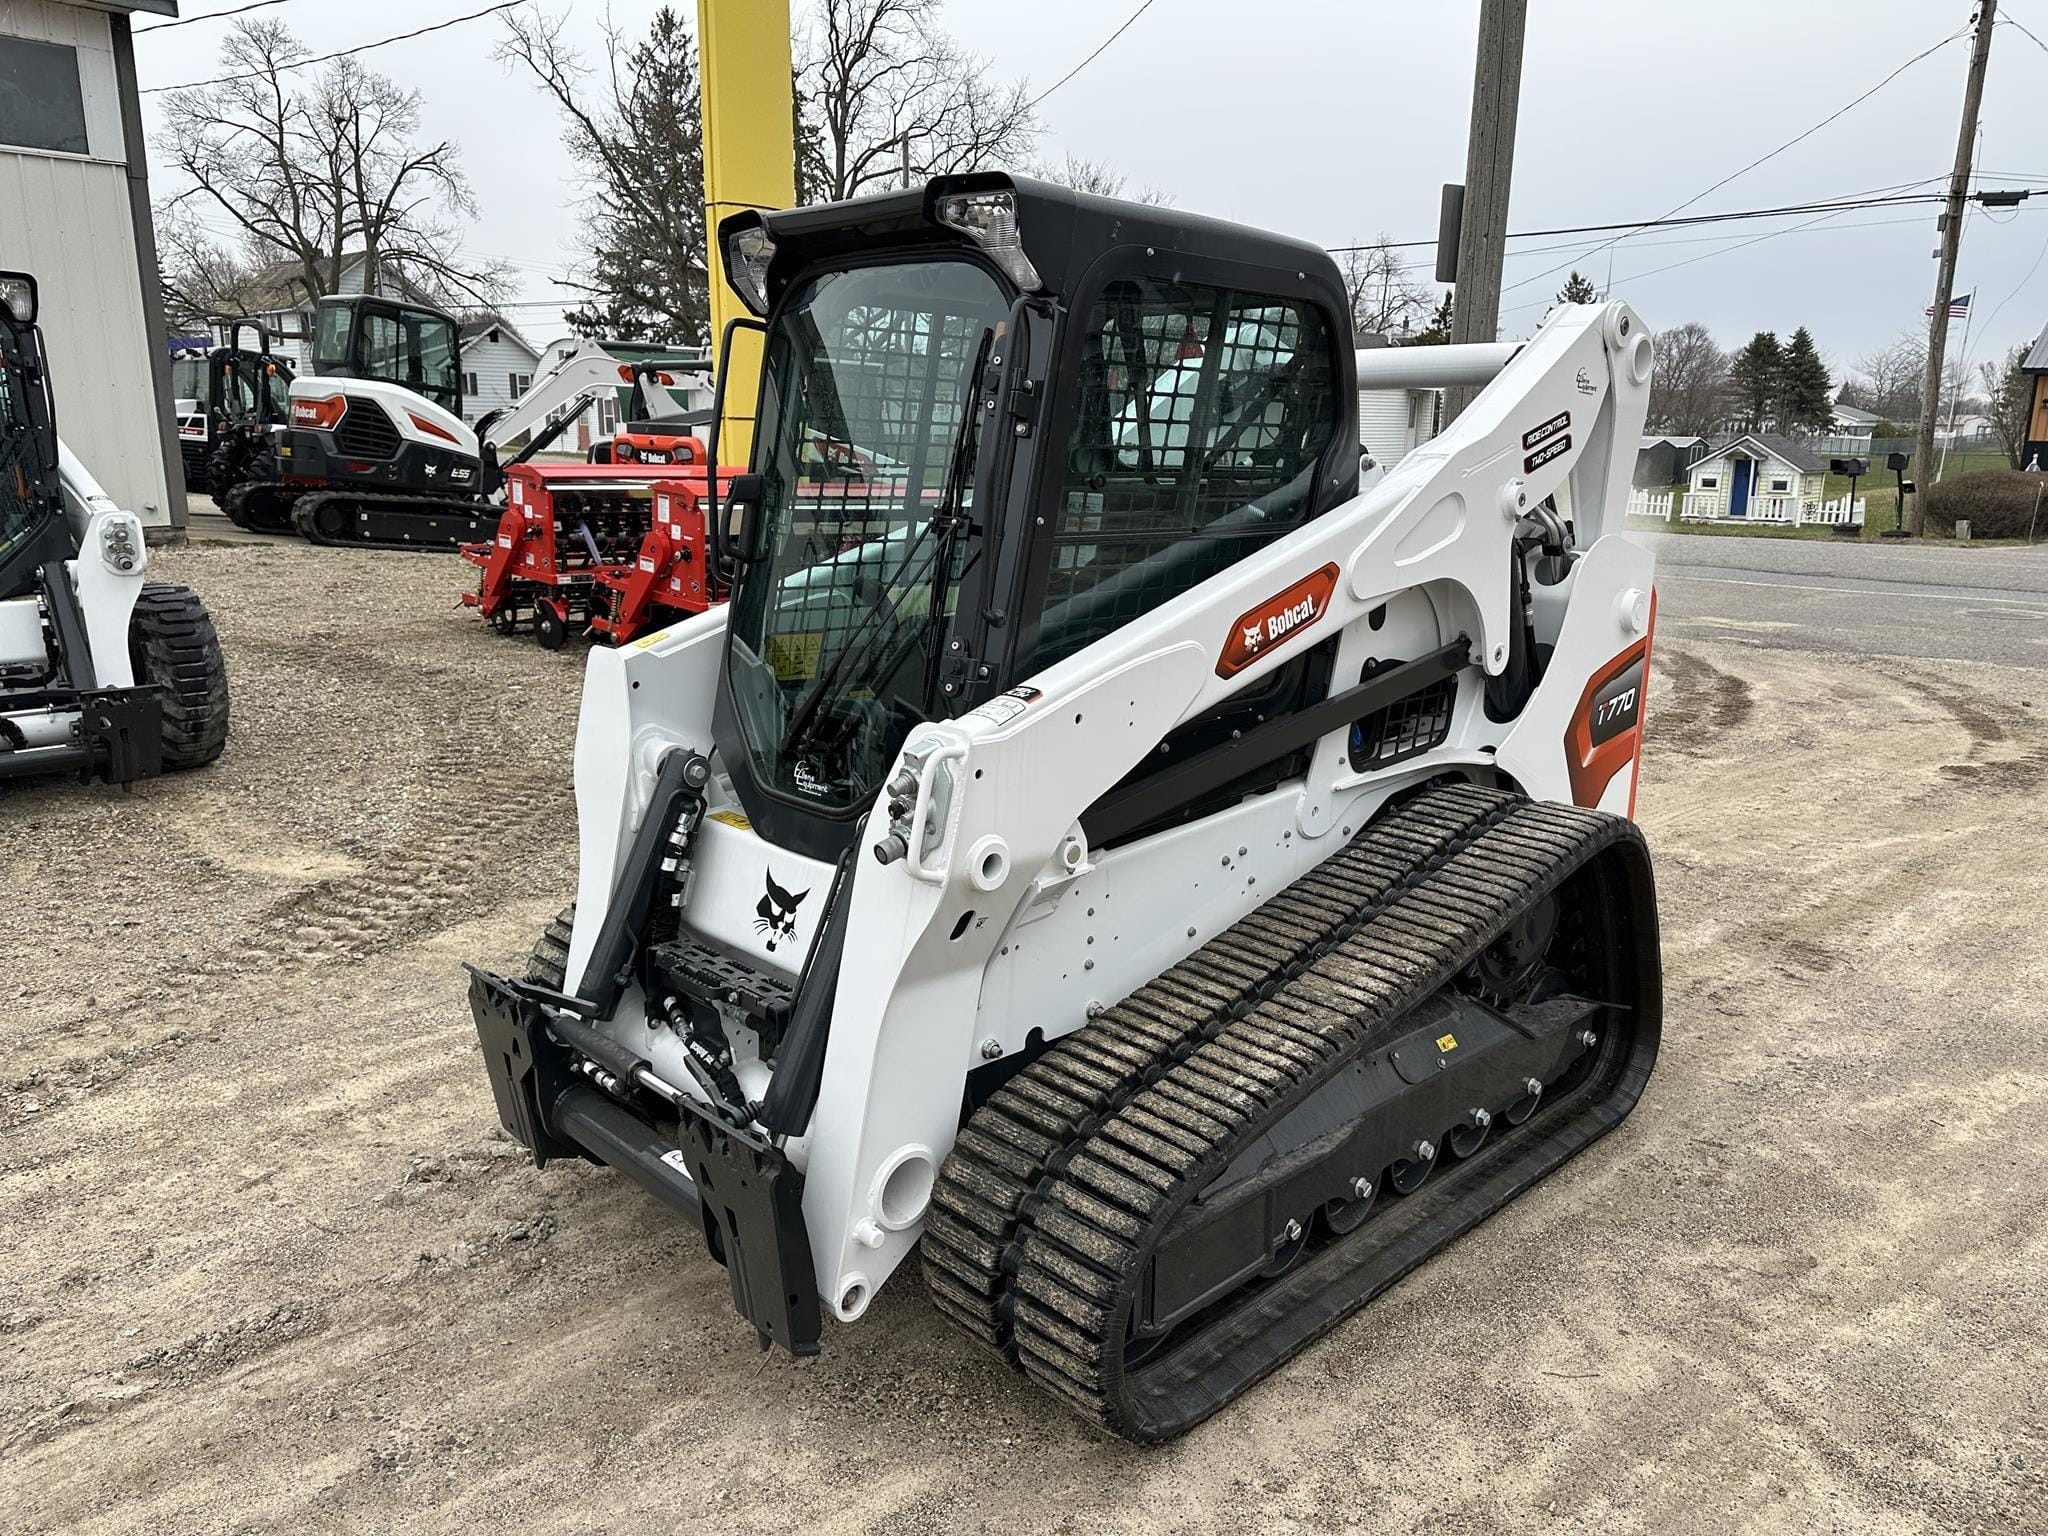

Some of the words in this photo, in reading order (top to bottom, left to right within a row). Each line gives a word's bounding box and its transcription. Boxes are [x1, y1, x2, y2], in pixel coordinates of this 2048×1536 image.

[295, 405, 317, 419] Bobcat
[1540, 415, 1568, 438] CONTROL
[648, 452, 666, 465] Bobcat
[1531, 439, 1567, 467] TWO-SPEED
[1267, 593, 1315, 641] Bobcat
[1598, 687, 1636, 726] T770
